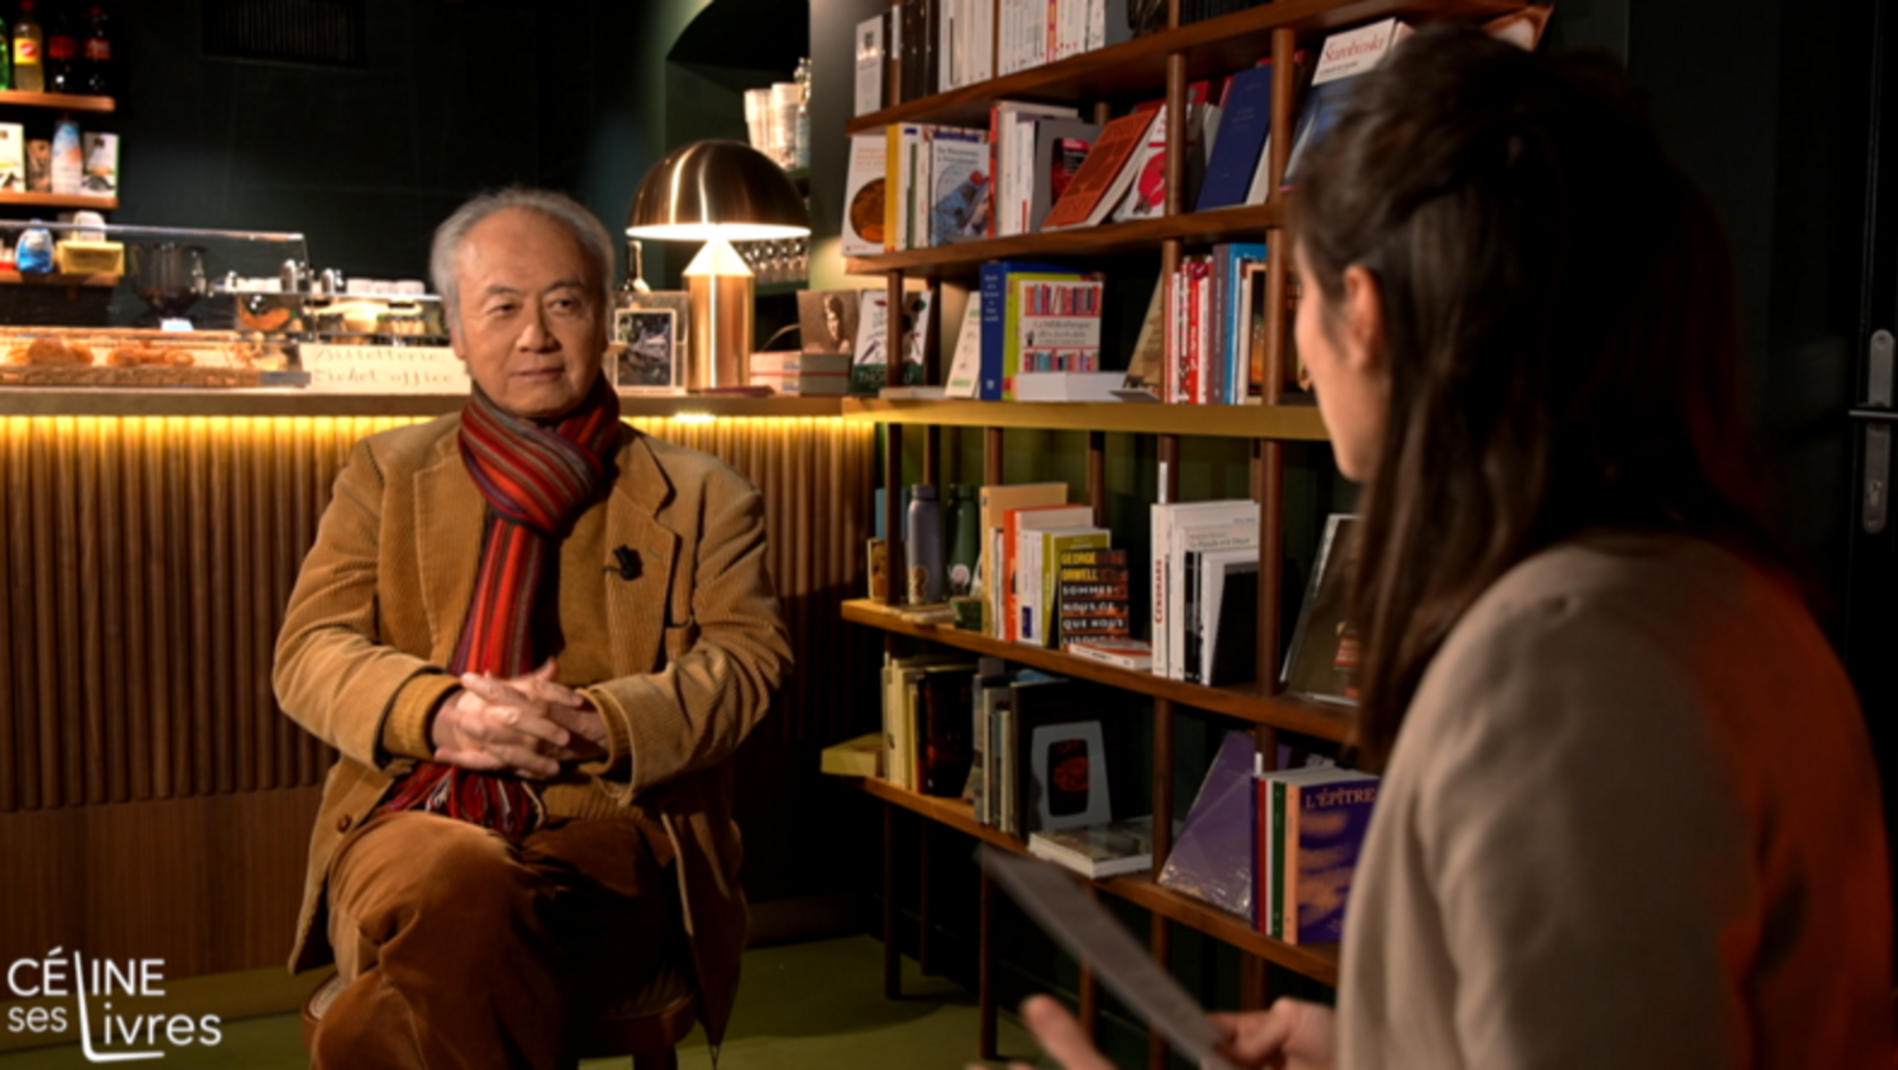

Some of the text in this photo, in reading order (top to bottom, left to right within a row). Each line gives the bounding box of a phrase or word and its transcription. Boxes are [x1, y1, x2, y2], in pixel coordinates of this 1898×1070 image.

[390, 370, 453, 386] office
[1061, 551, 1097, 565] GEORGE
[1061, 568, 1098, 581] ORWELL
[1062, 601, 1097, 612] NOUS
[1062, 618, 1124, 630] QUE NOUS
